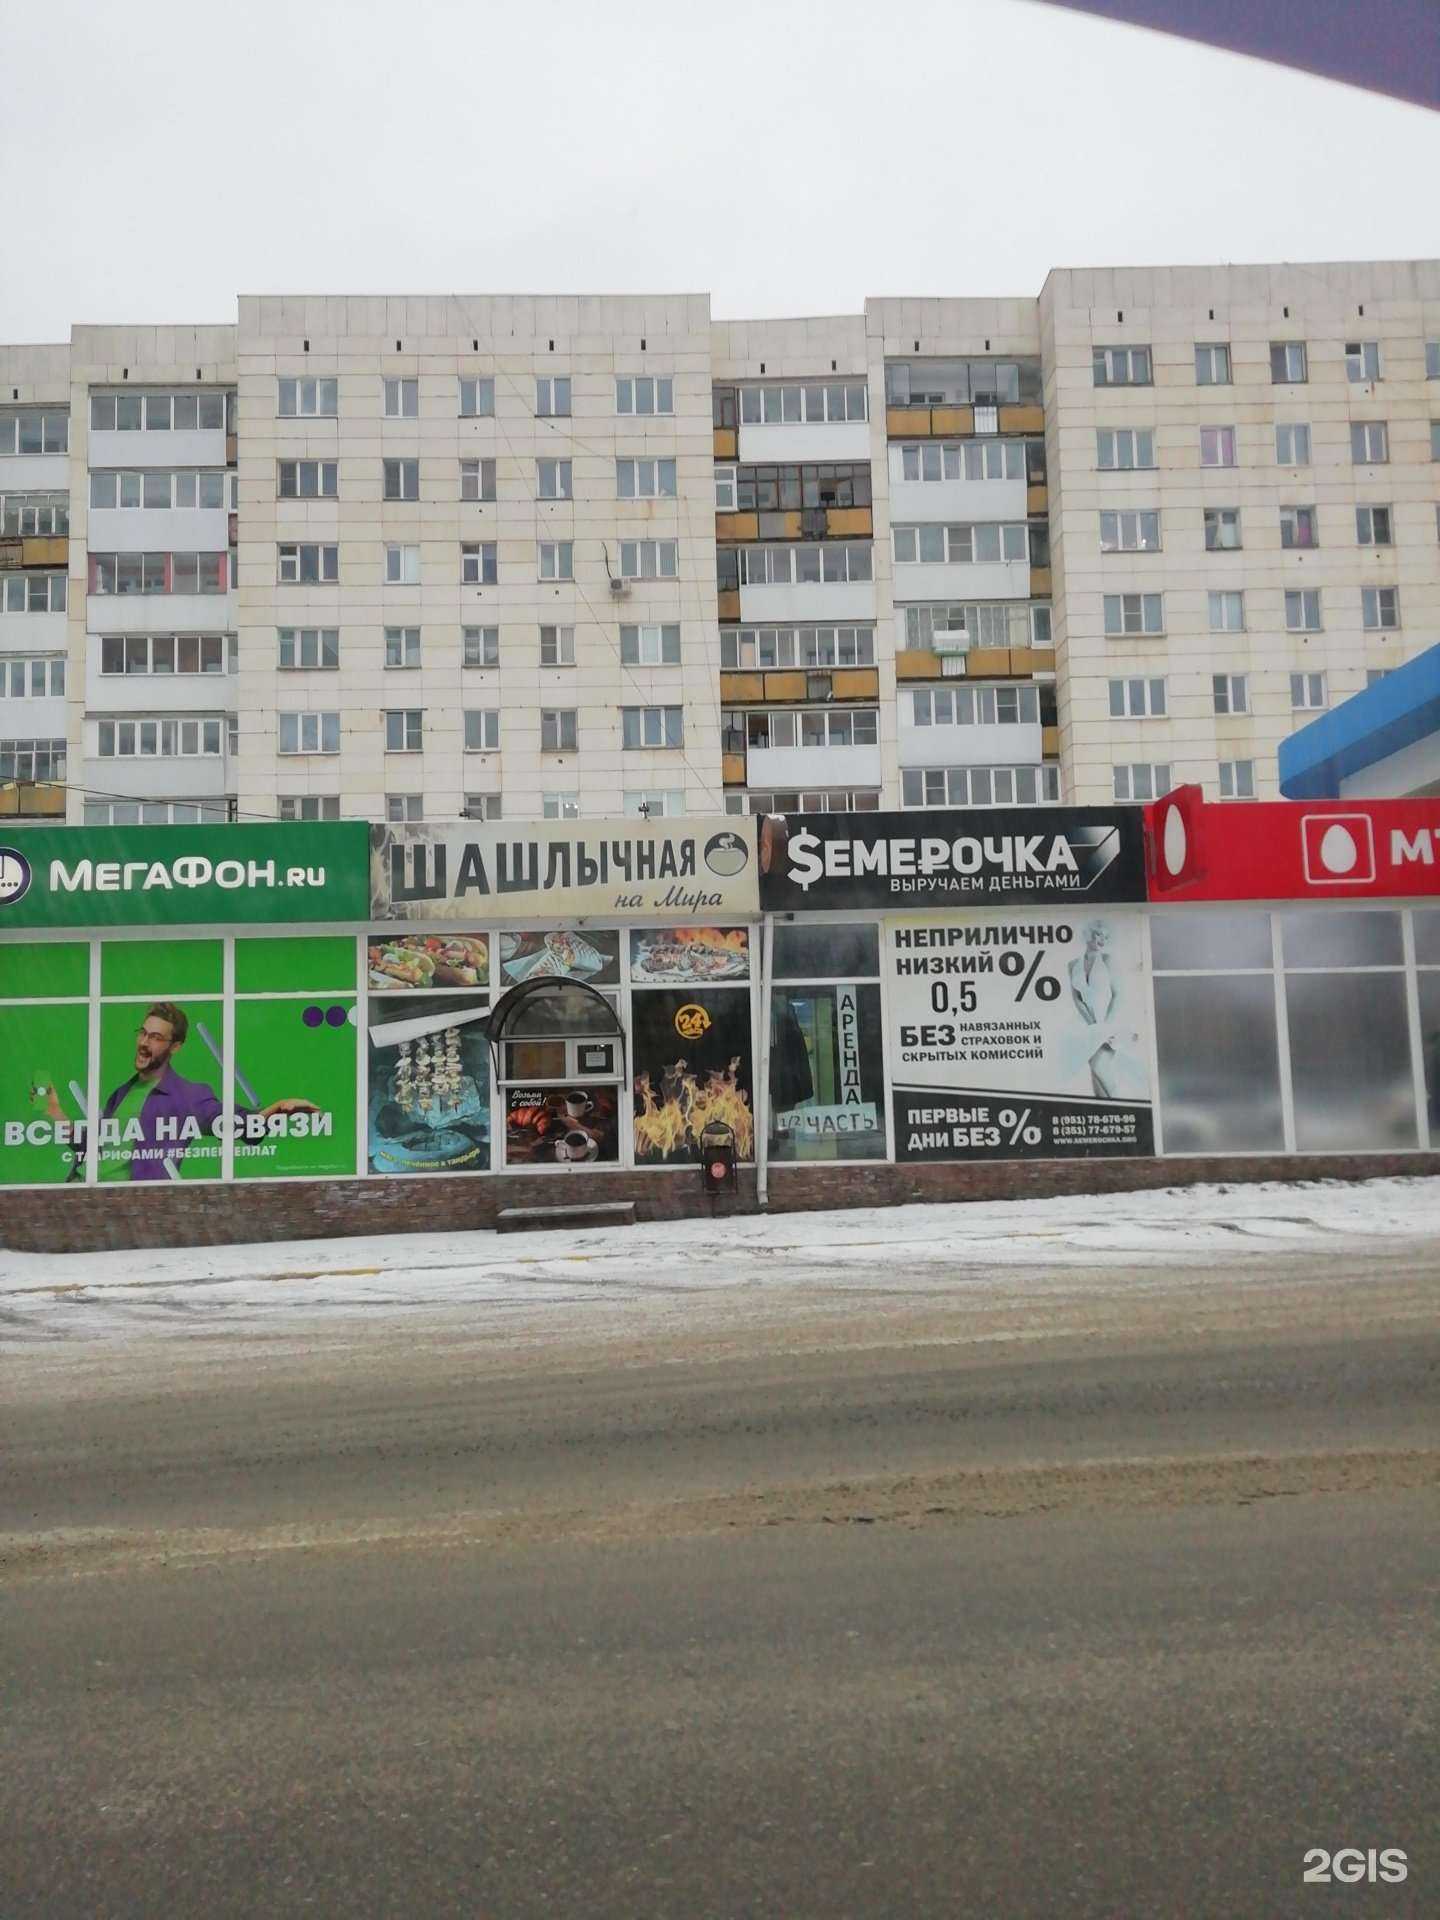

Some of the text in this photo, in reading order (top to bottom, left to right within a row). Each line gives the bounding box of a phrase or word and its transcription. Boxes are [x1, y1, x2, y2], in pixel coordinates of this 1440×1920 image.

[391, 839, 696, 902] ШАШЛЫЧНАЯ
[890, 874, 1081, 892] ВЫРУЧАЕМ ДЕНЬГАМИ
[614, 885, 723, 913] на Мира
[895, 925, 1073, 948] НЕПРИЛИЧНО
[896, 950, 1062, 1002] НИЗКИЙ %
[931, 981, 977, 1016] 0,5
[900, 1021, 1041, 1047] БЕЗ НАВЯЗАННЫХ
[961, 1035, 1042, 1046] СТРАХОВОК И
[840, 994, 862, 1106] АРЕНДА
[902, 1047, 1044, 1062] СКРЫТЫХ КОМИССИЙ
[155, 1116, 202, 1140] НА
[211, 1111, 333, 1140] СВЯЗИ
[807, 1113, 874, 1134] ЧАСТЬ
[908, 1107, 990, 1125] ПЕРВЫЕ
[907, 1108, 1042, 1151] ДНИ БЕЗ %
[62, 1151, 72, 1162] С
